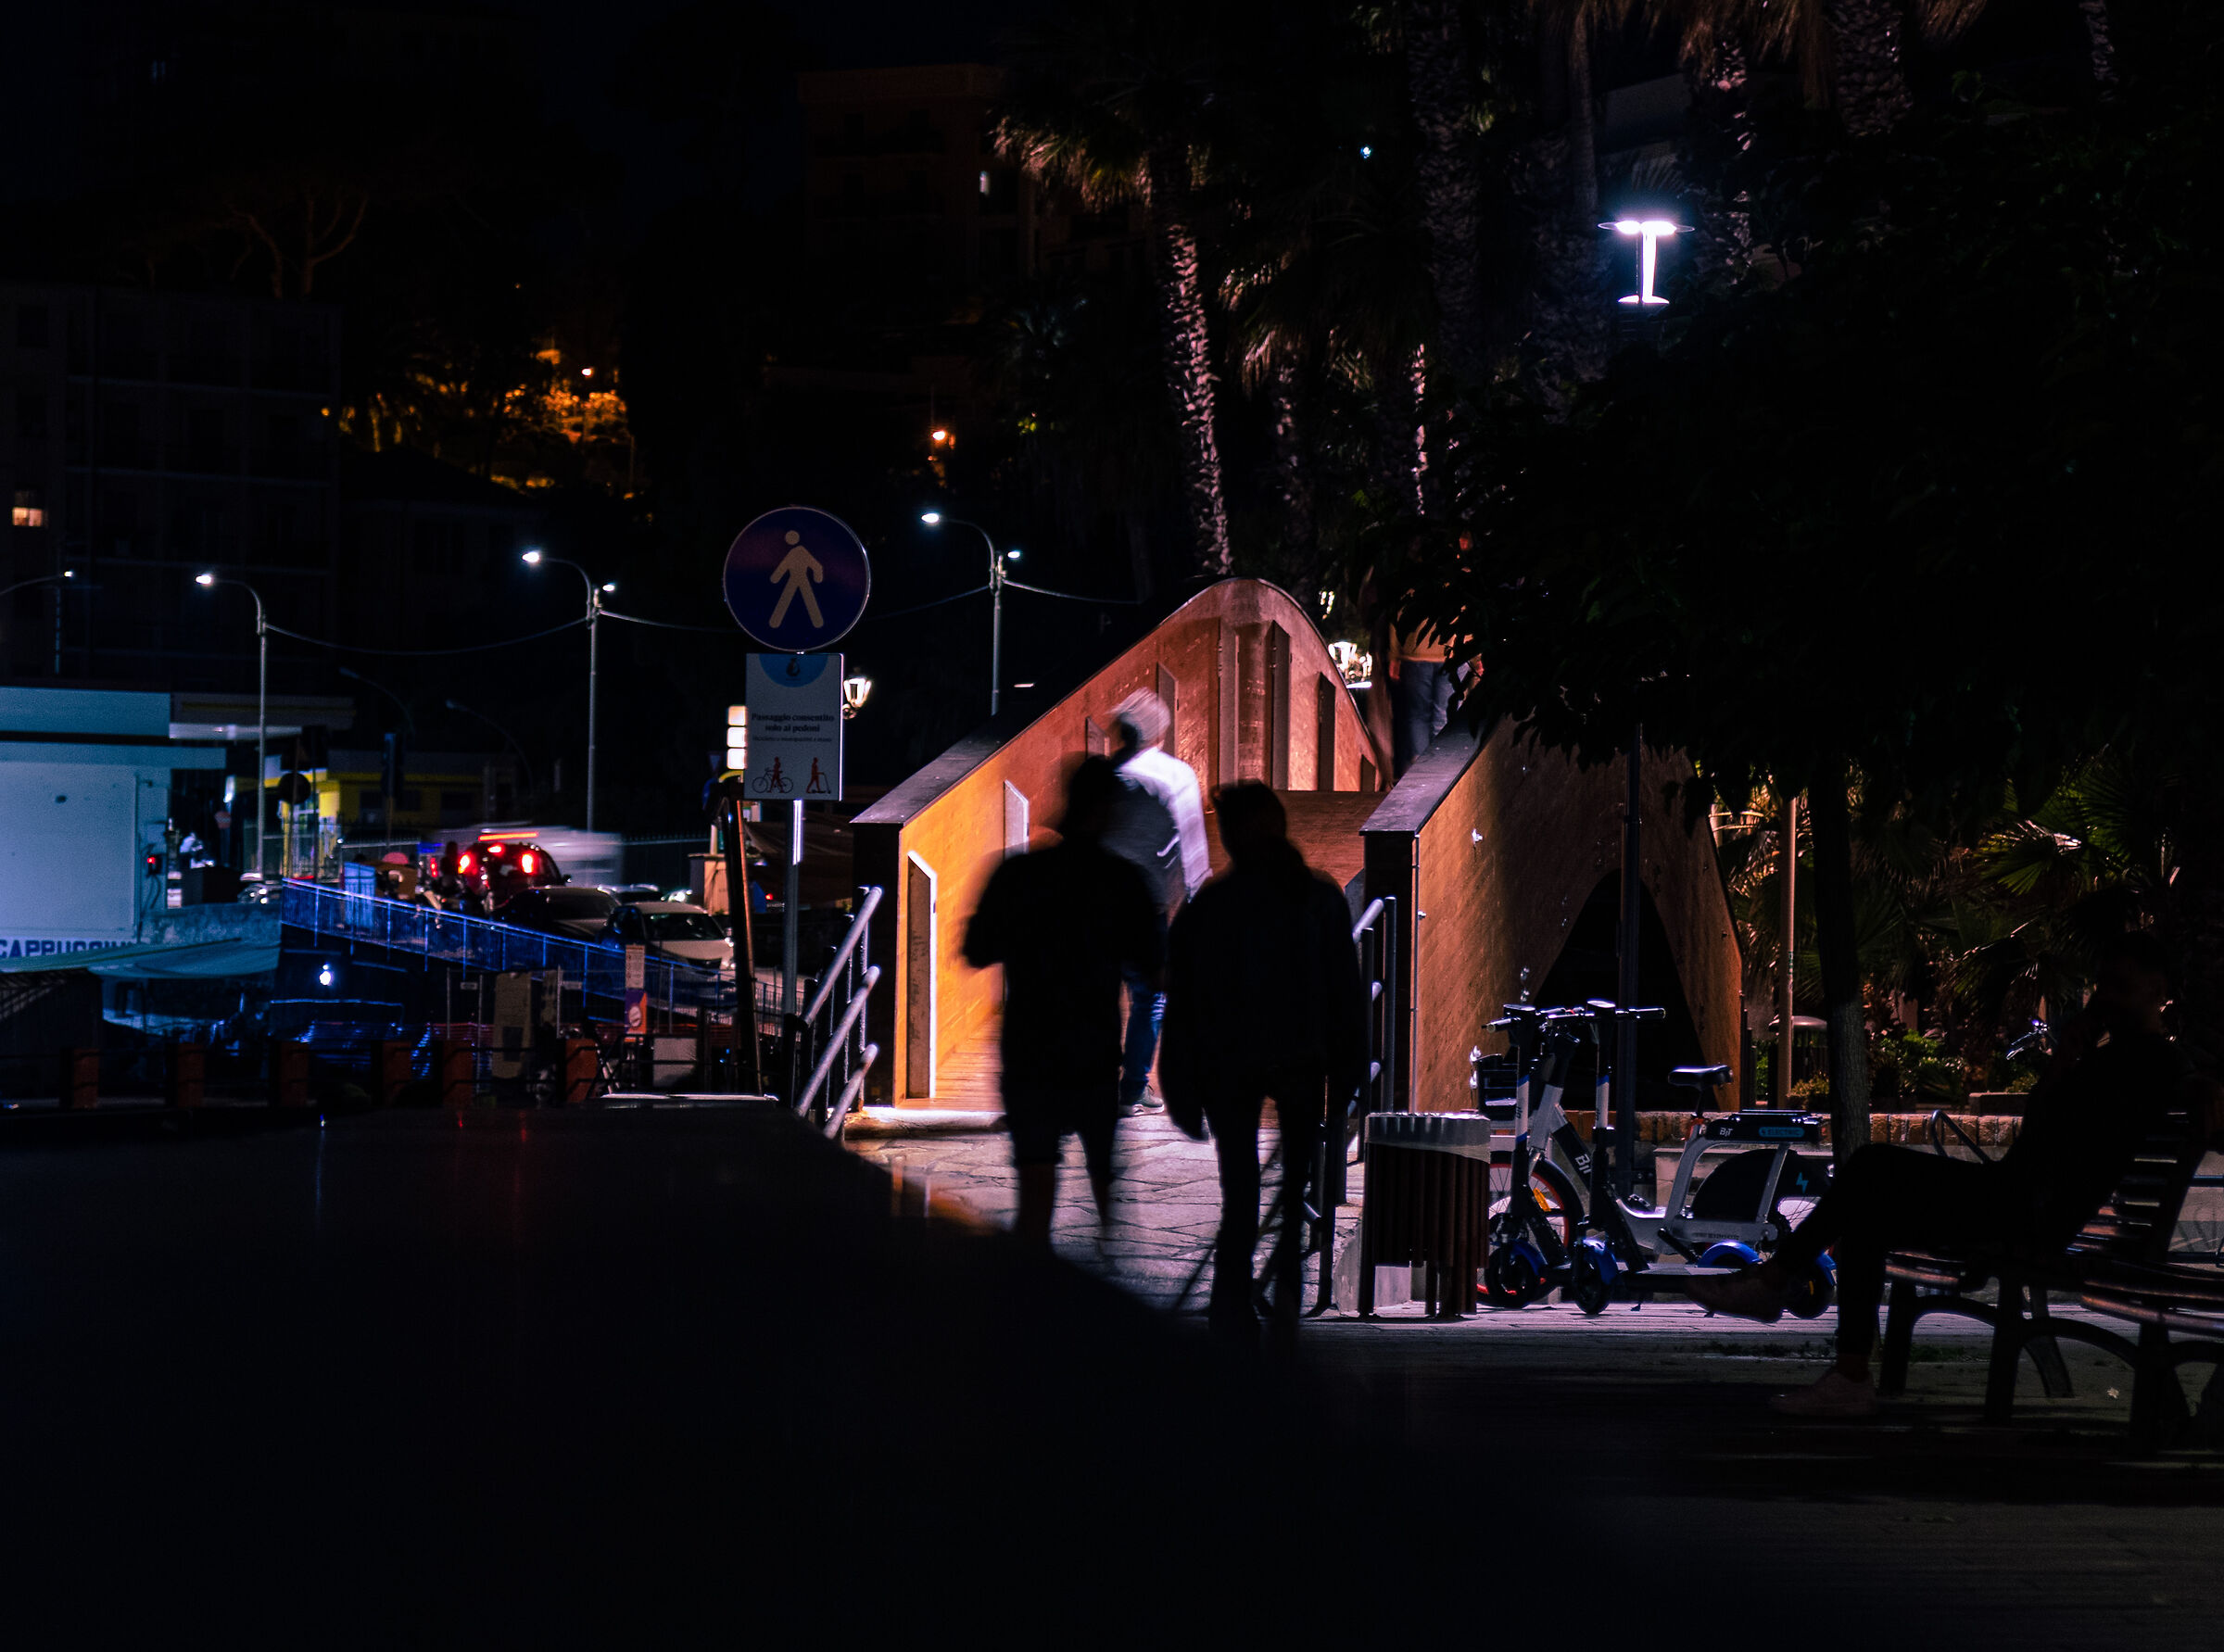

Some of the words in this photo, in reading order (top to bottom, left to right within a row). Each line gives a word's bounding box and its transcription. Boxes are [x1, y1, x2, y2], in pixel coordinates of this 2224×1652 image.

[752, 713, 790, 723] Passaggio
[792, 713, 835, 722] consentito
[765, 724, 782, 732] solo
[783, 724, 791, 732] ai
[792, 724, 820, 734] pedoni
